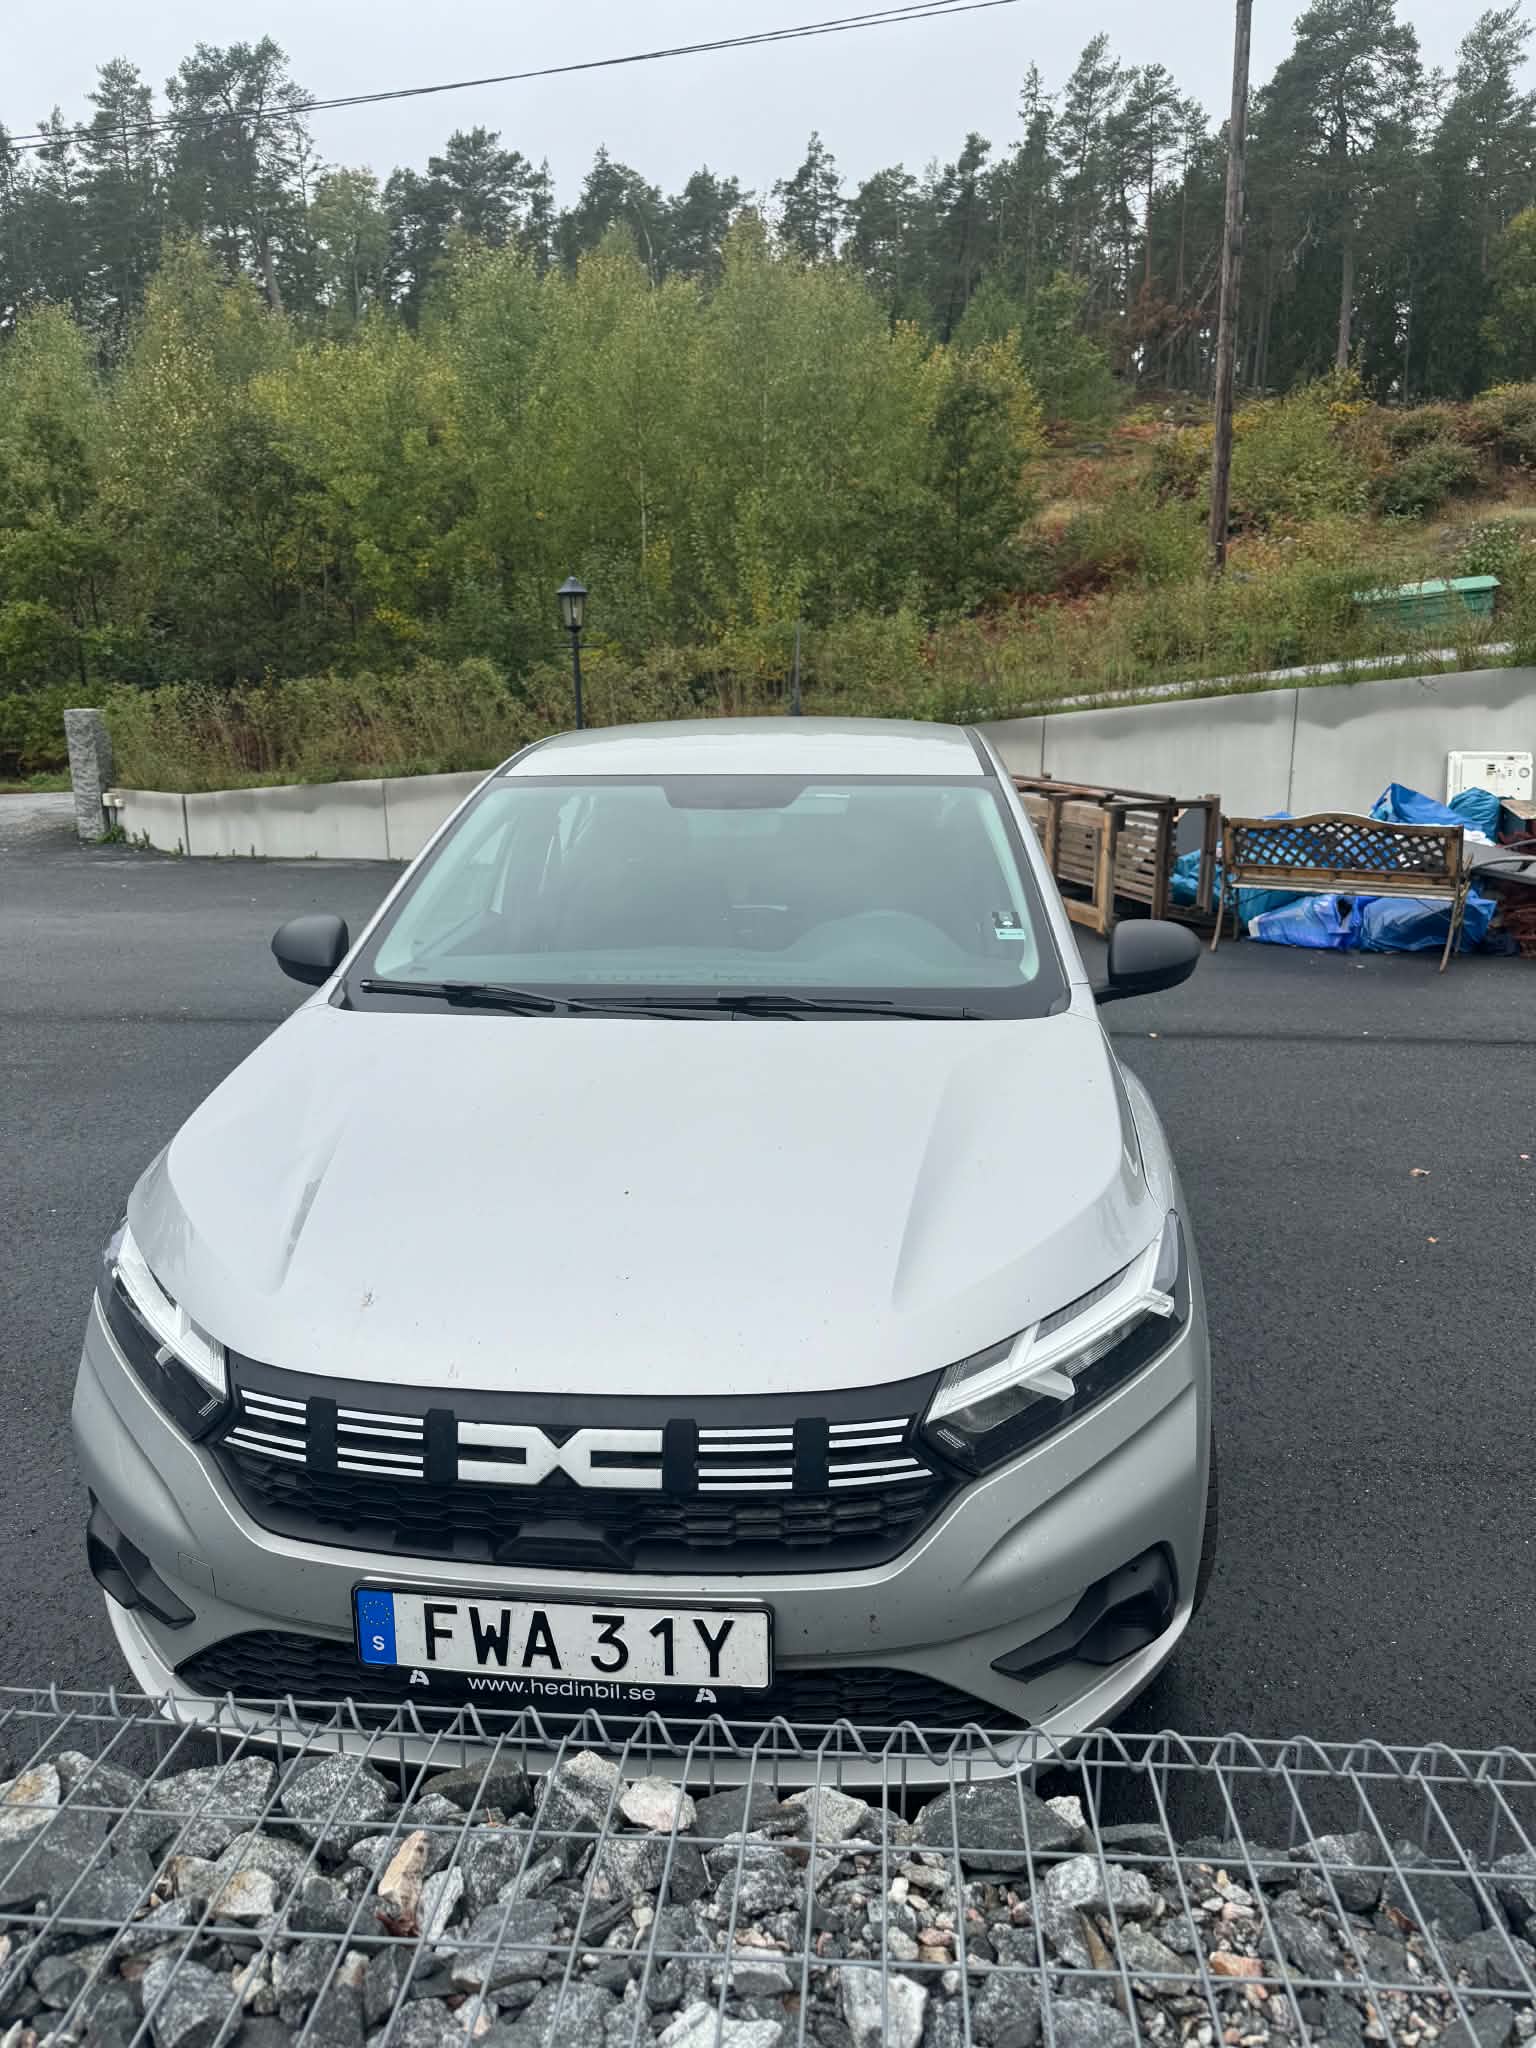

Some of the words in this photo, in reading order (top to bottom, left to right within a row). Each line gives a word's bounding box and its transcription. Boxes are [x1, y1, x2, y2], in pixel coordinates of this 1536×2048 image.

[372, 1635, 386, 1651] S
[424, 1603, 562, 1670] FWA
[590, 1614, 735, 1678] 31Y
[467, 1676, 656, 1701] www.hedinbil.se
